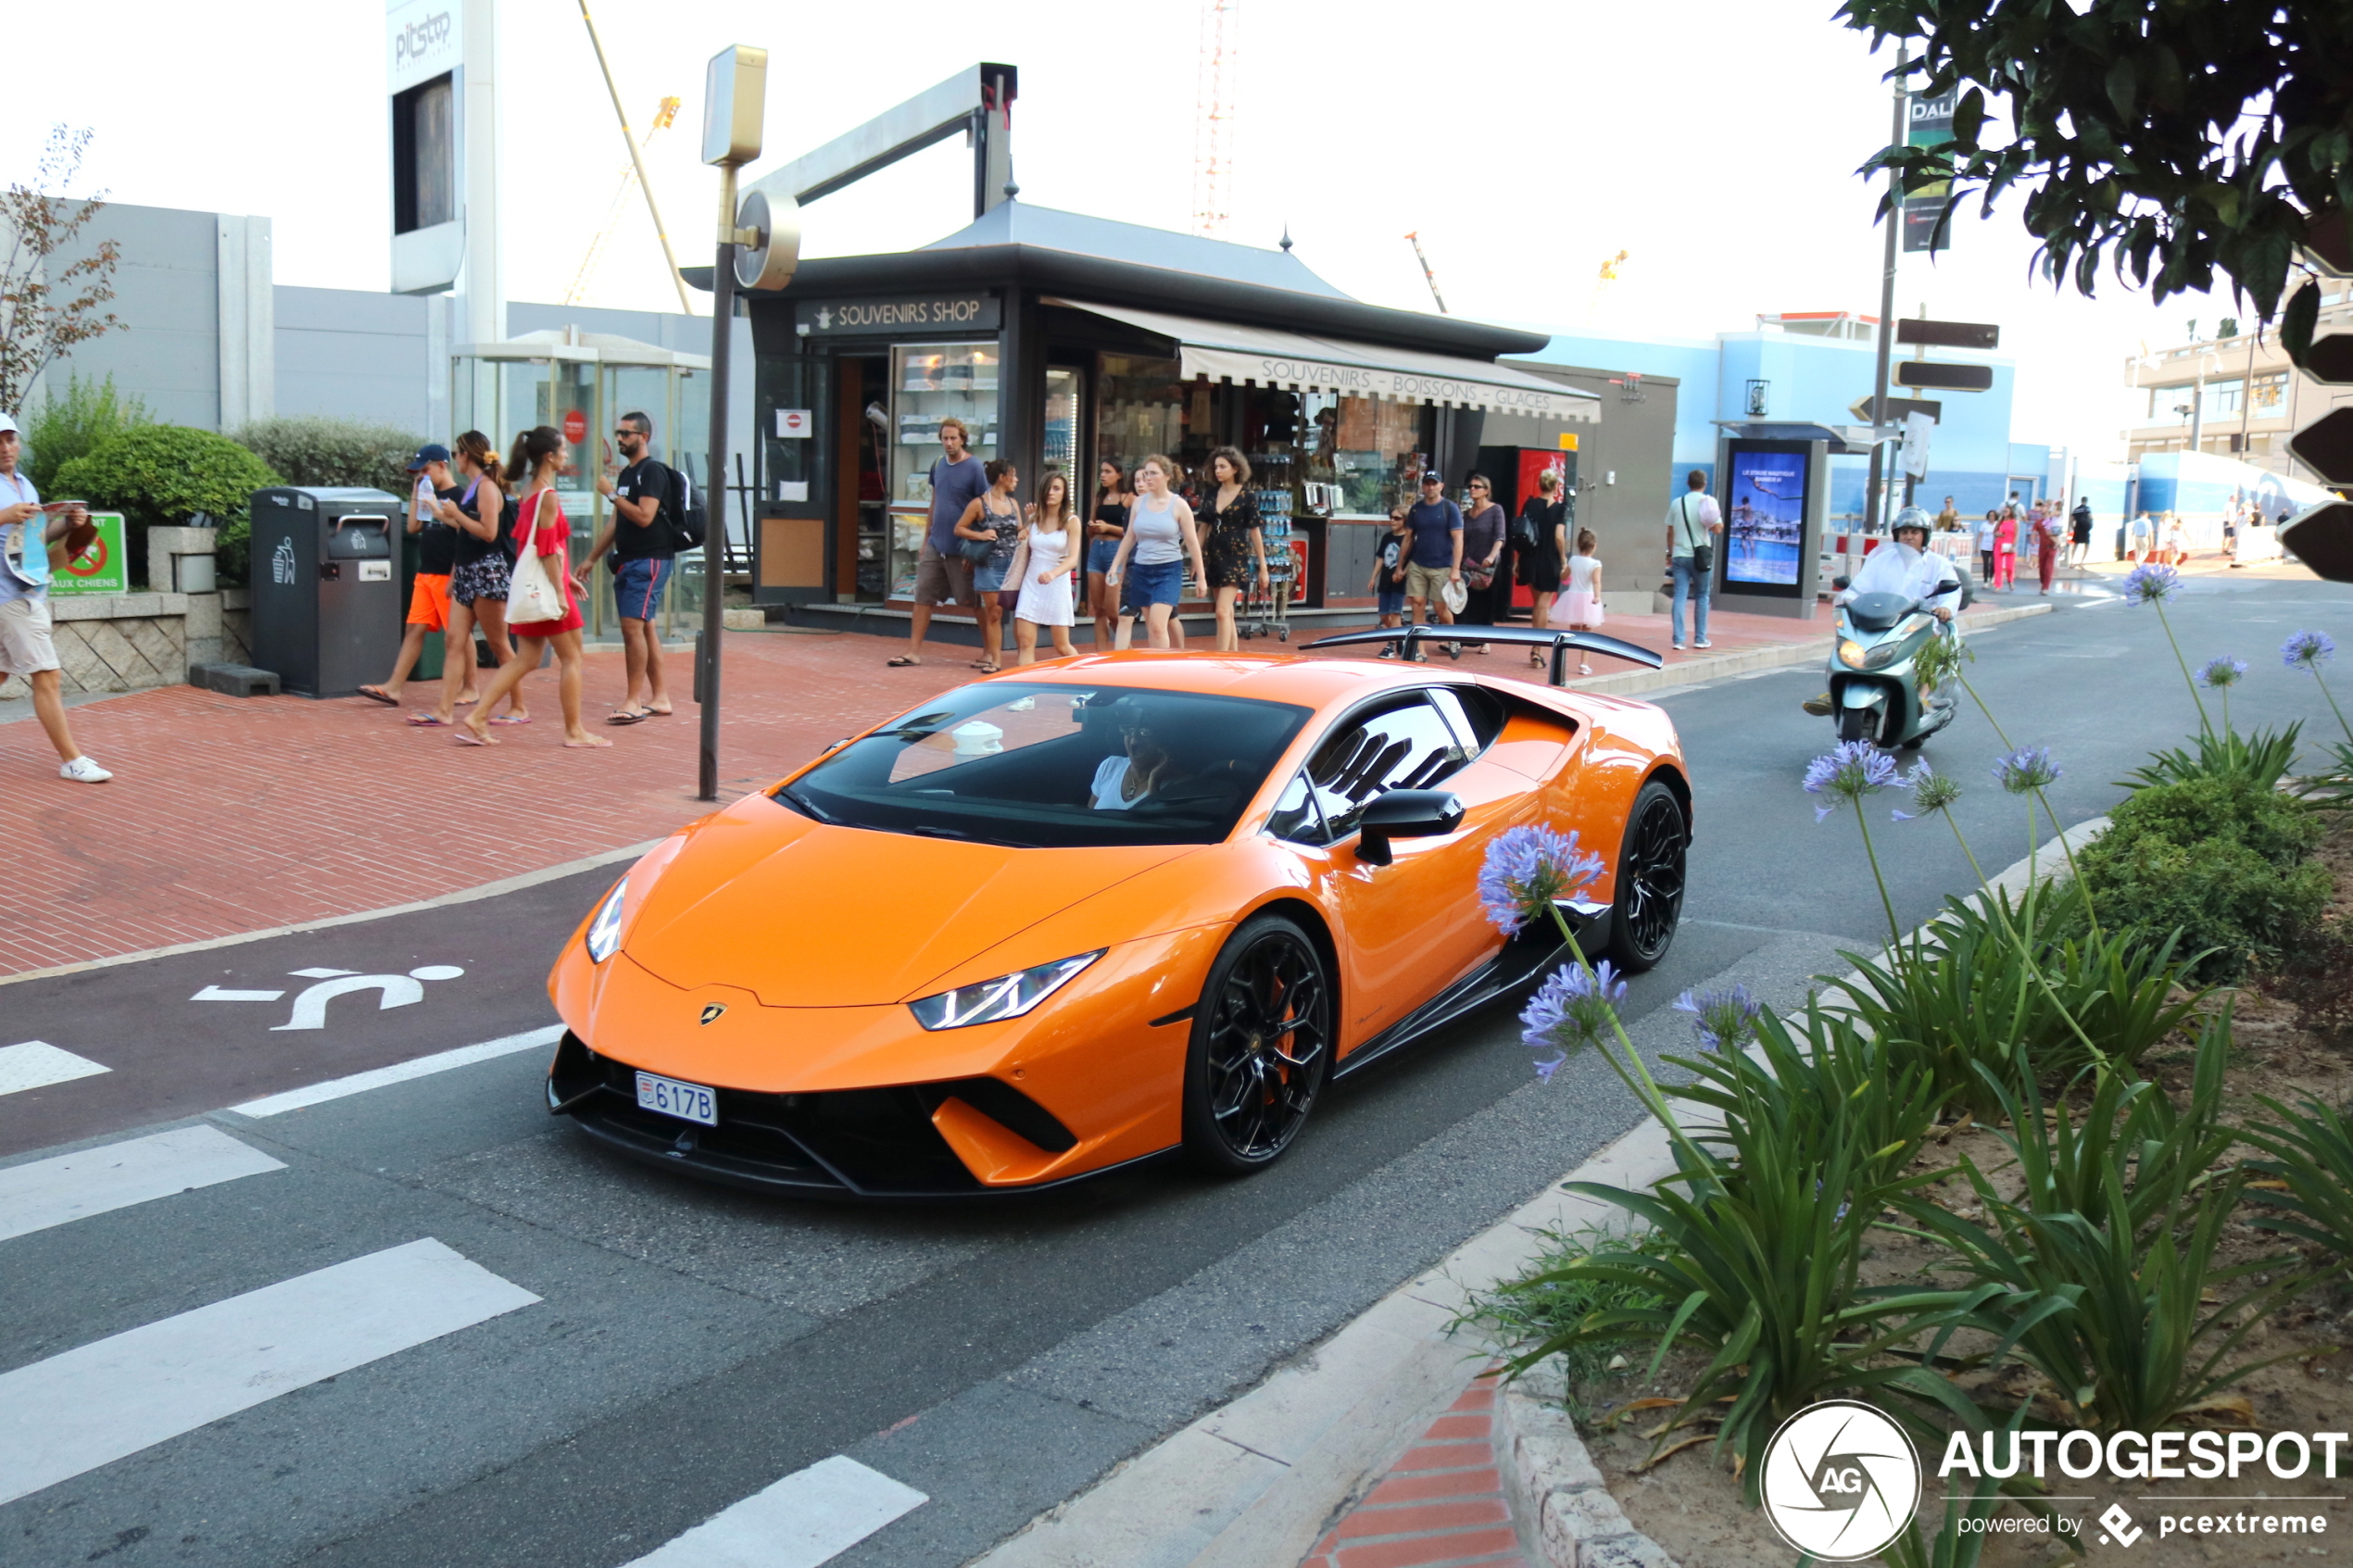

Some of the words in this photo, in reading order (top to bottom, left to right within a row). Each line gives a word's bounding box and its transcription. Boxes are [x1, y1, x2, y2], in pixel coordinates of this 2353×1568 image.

[396, 11, 450, 66] pitstop
[838, 302, 927, 326] SOUVENIRS
[933, 300, 980, 322] SHOP
[1262, 359, 1370, 388] SOUVENIRS
[1392, 376, 1478, 401] BOISSONS
[1495, 389, 1551, 410] GLACES
[51, 579, 74, 588] AUX
[76, 578, 119, 588] CHIENS
[656, 1082, 711, 1119] 617B
